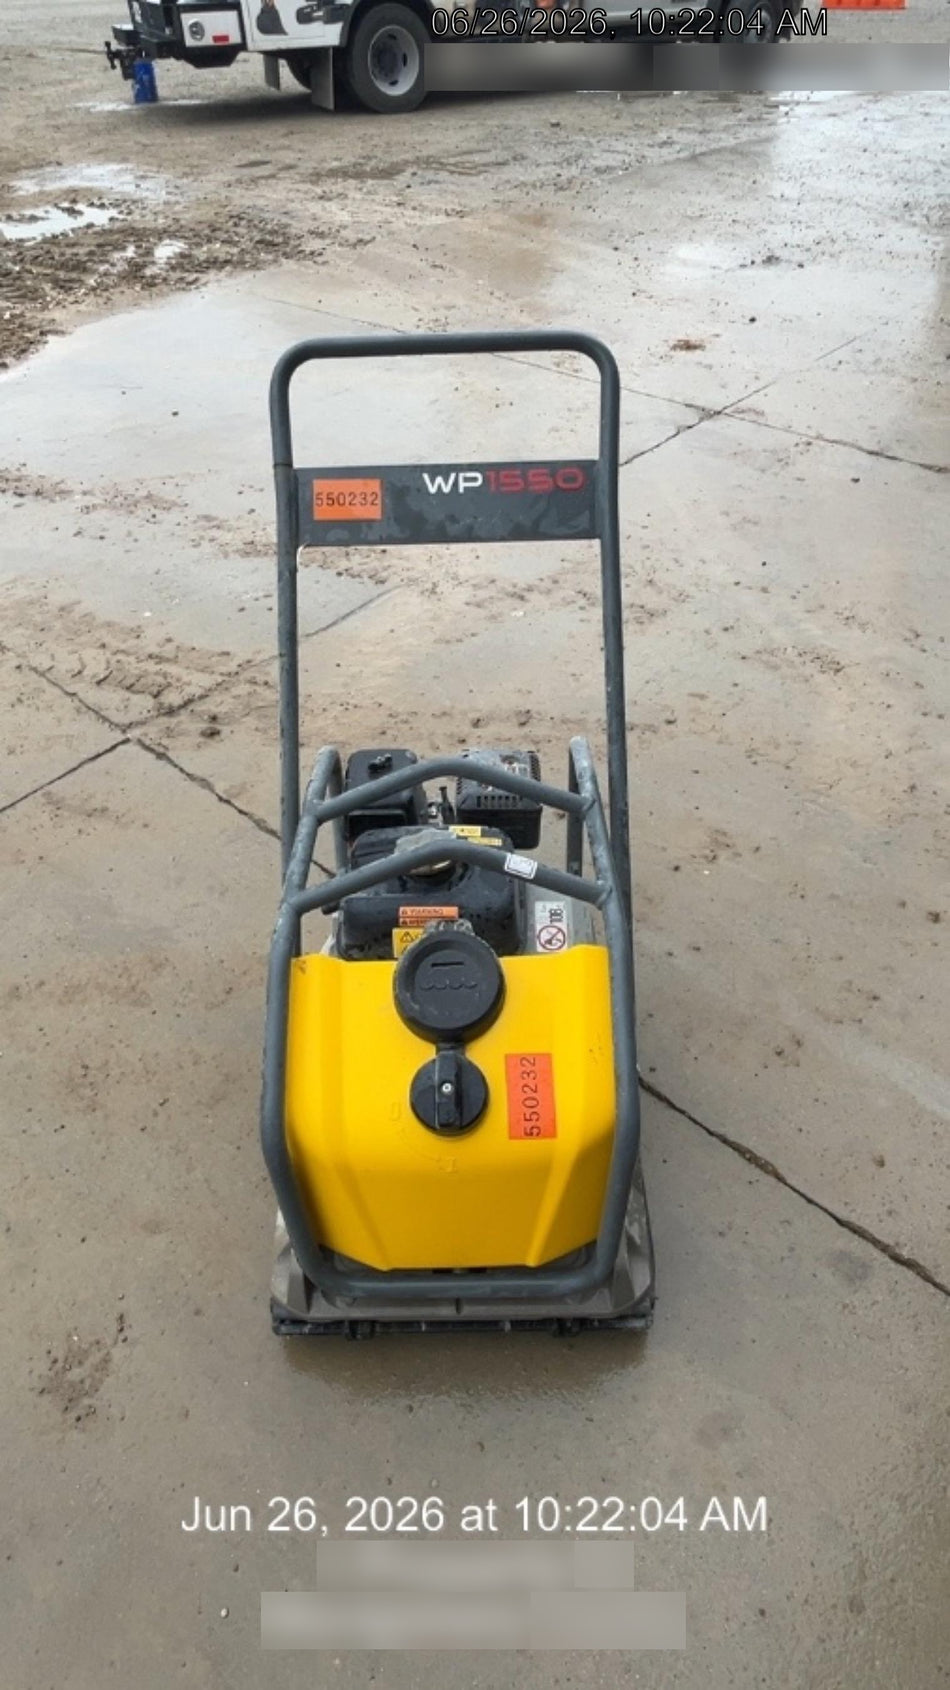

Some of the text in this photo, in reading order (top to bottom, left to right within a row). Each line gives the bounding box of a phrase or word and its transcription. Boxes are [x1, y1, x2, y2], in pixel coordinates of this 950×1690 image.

[422, 467, 586, 493] WP1550
[315, 491, 379, 507] 550232
[520, 1056, 541, 1137] 550232
